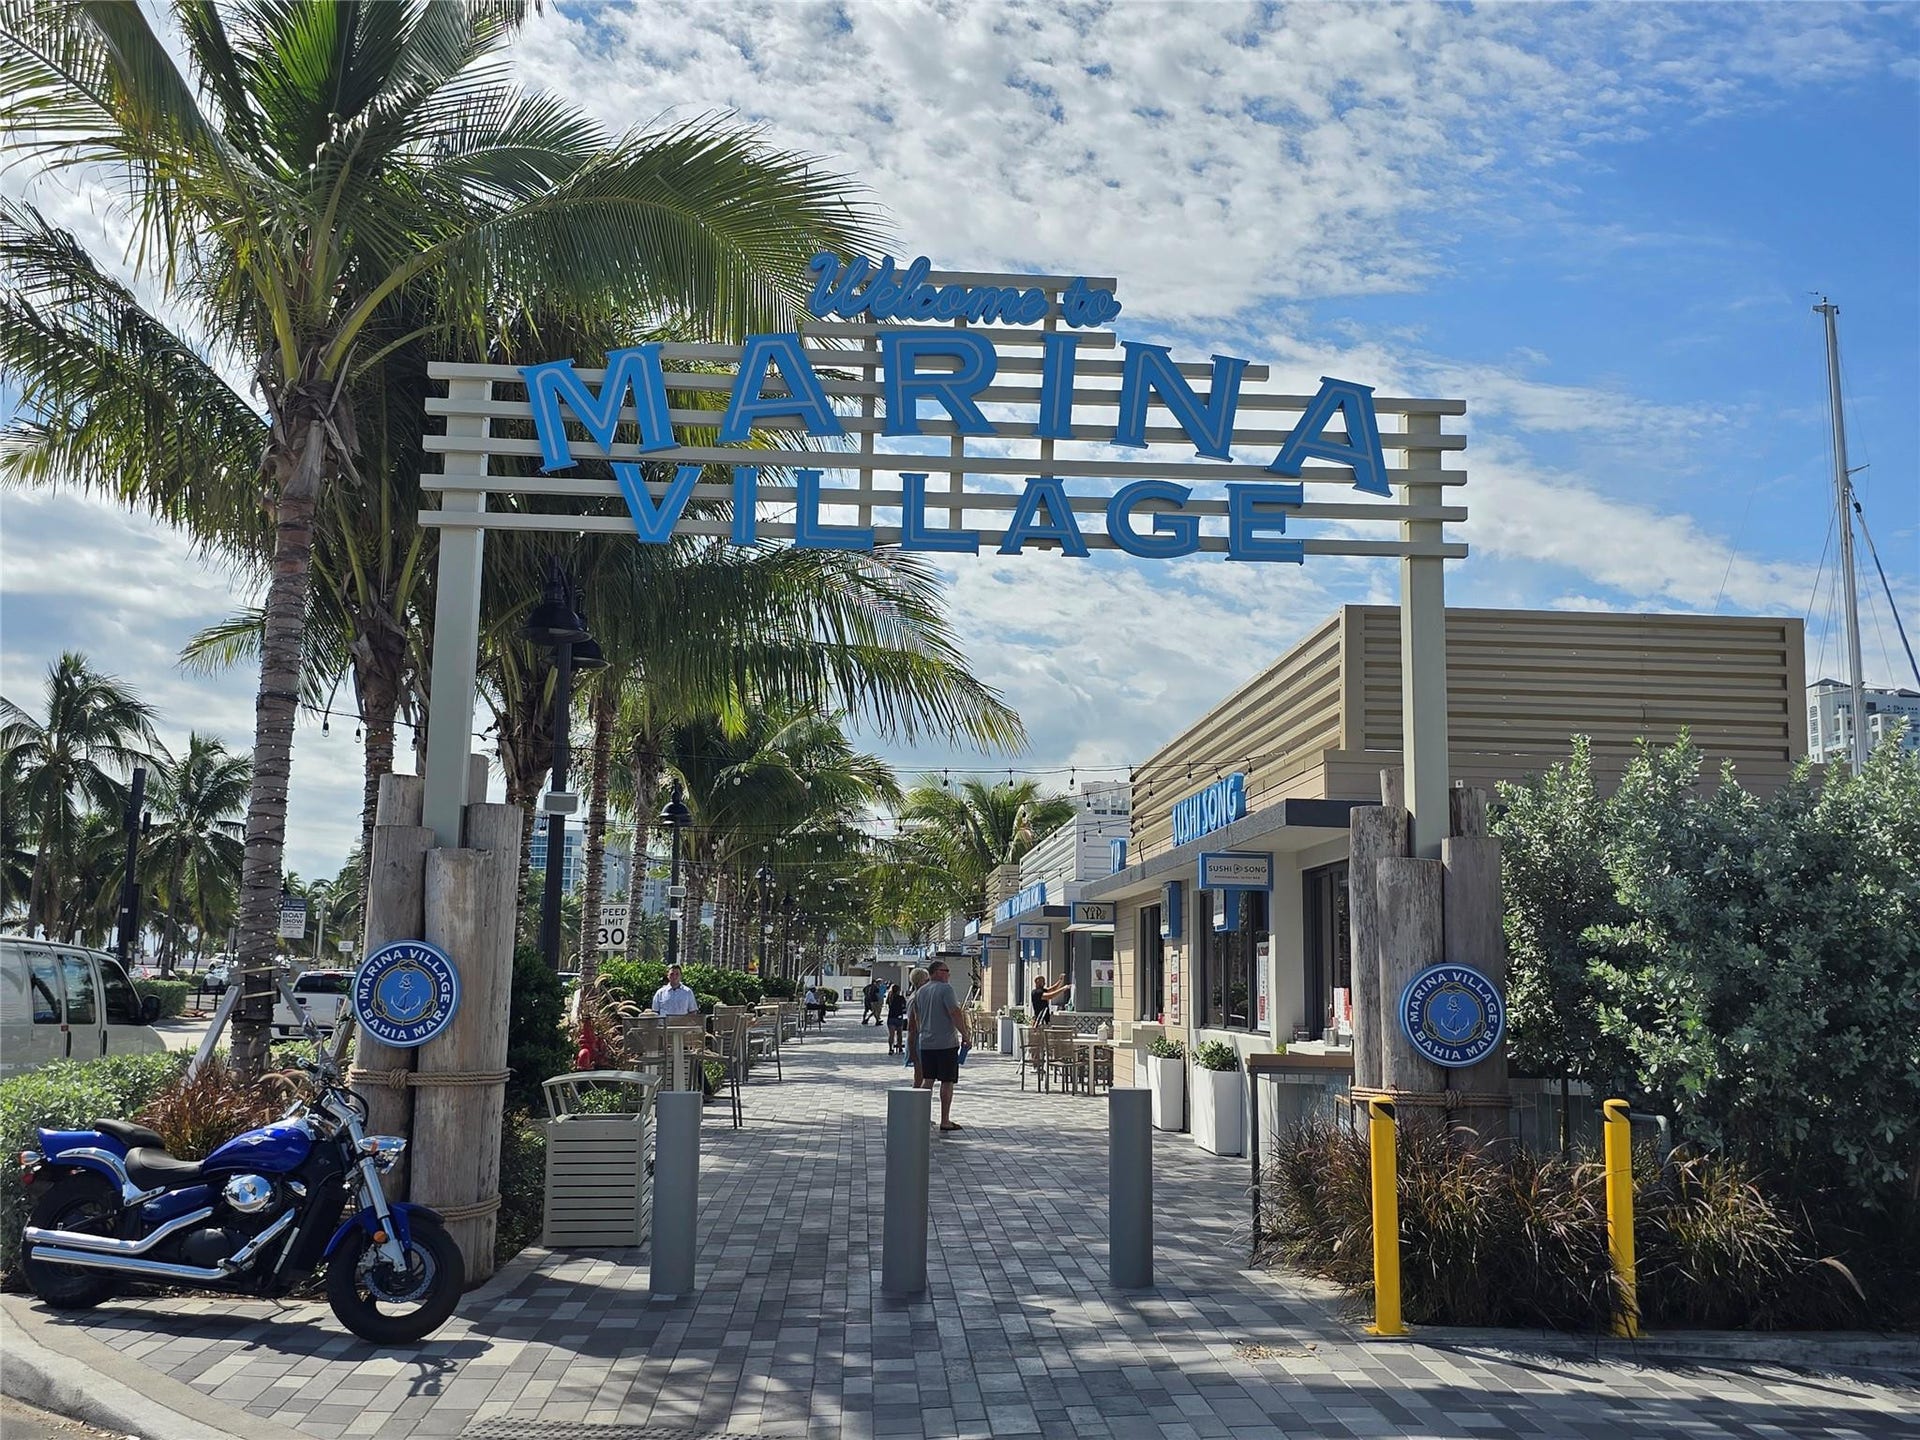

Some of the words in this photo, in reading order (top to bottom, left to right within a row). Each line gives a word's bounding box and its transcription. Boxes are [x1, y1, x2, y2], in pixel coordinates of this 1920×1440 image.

[810, 251, 1048, 325] Welcome
[1063, 276, 1122, 328] to
[517, 329, 1393, 498] MARINA
[612, 461, 1304, 565] VILLAGE
[1171, 793, 1200, 848] SUSHI
[1201, 778, 1237, 834] SONG
[1208, 864, 1232, 872] SUSHI
[1243, 865, 1267, 873] SONG
[600, 918, 623, 926] IMIT
[602, 908, 627, 916] PEED
[598, 928, 625, 945] 30
[360, 949, 403, 999] MARINA
[409, 948, 450, 1003] VILLAGE
[1410, 973, 1447, 1022] MARINA
[1452, 972, 1497, 1023] VILLAGE
[362, 1008, 407, 1039] BAHIA
[413, 1010, 445, 1037] MAR
[1416, 1031, 1461, 1059] BAHIA
[1466, 1030, 1494, 1057] MAR
